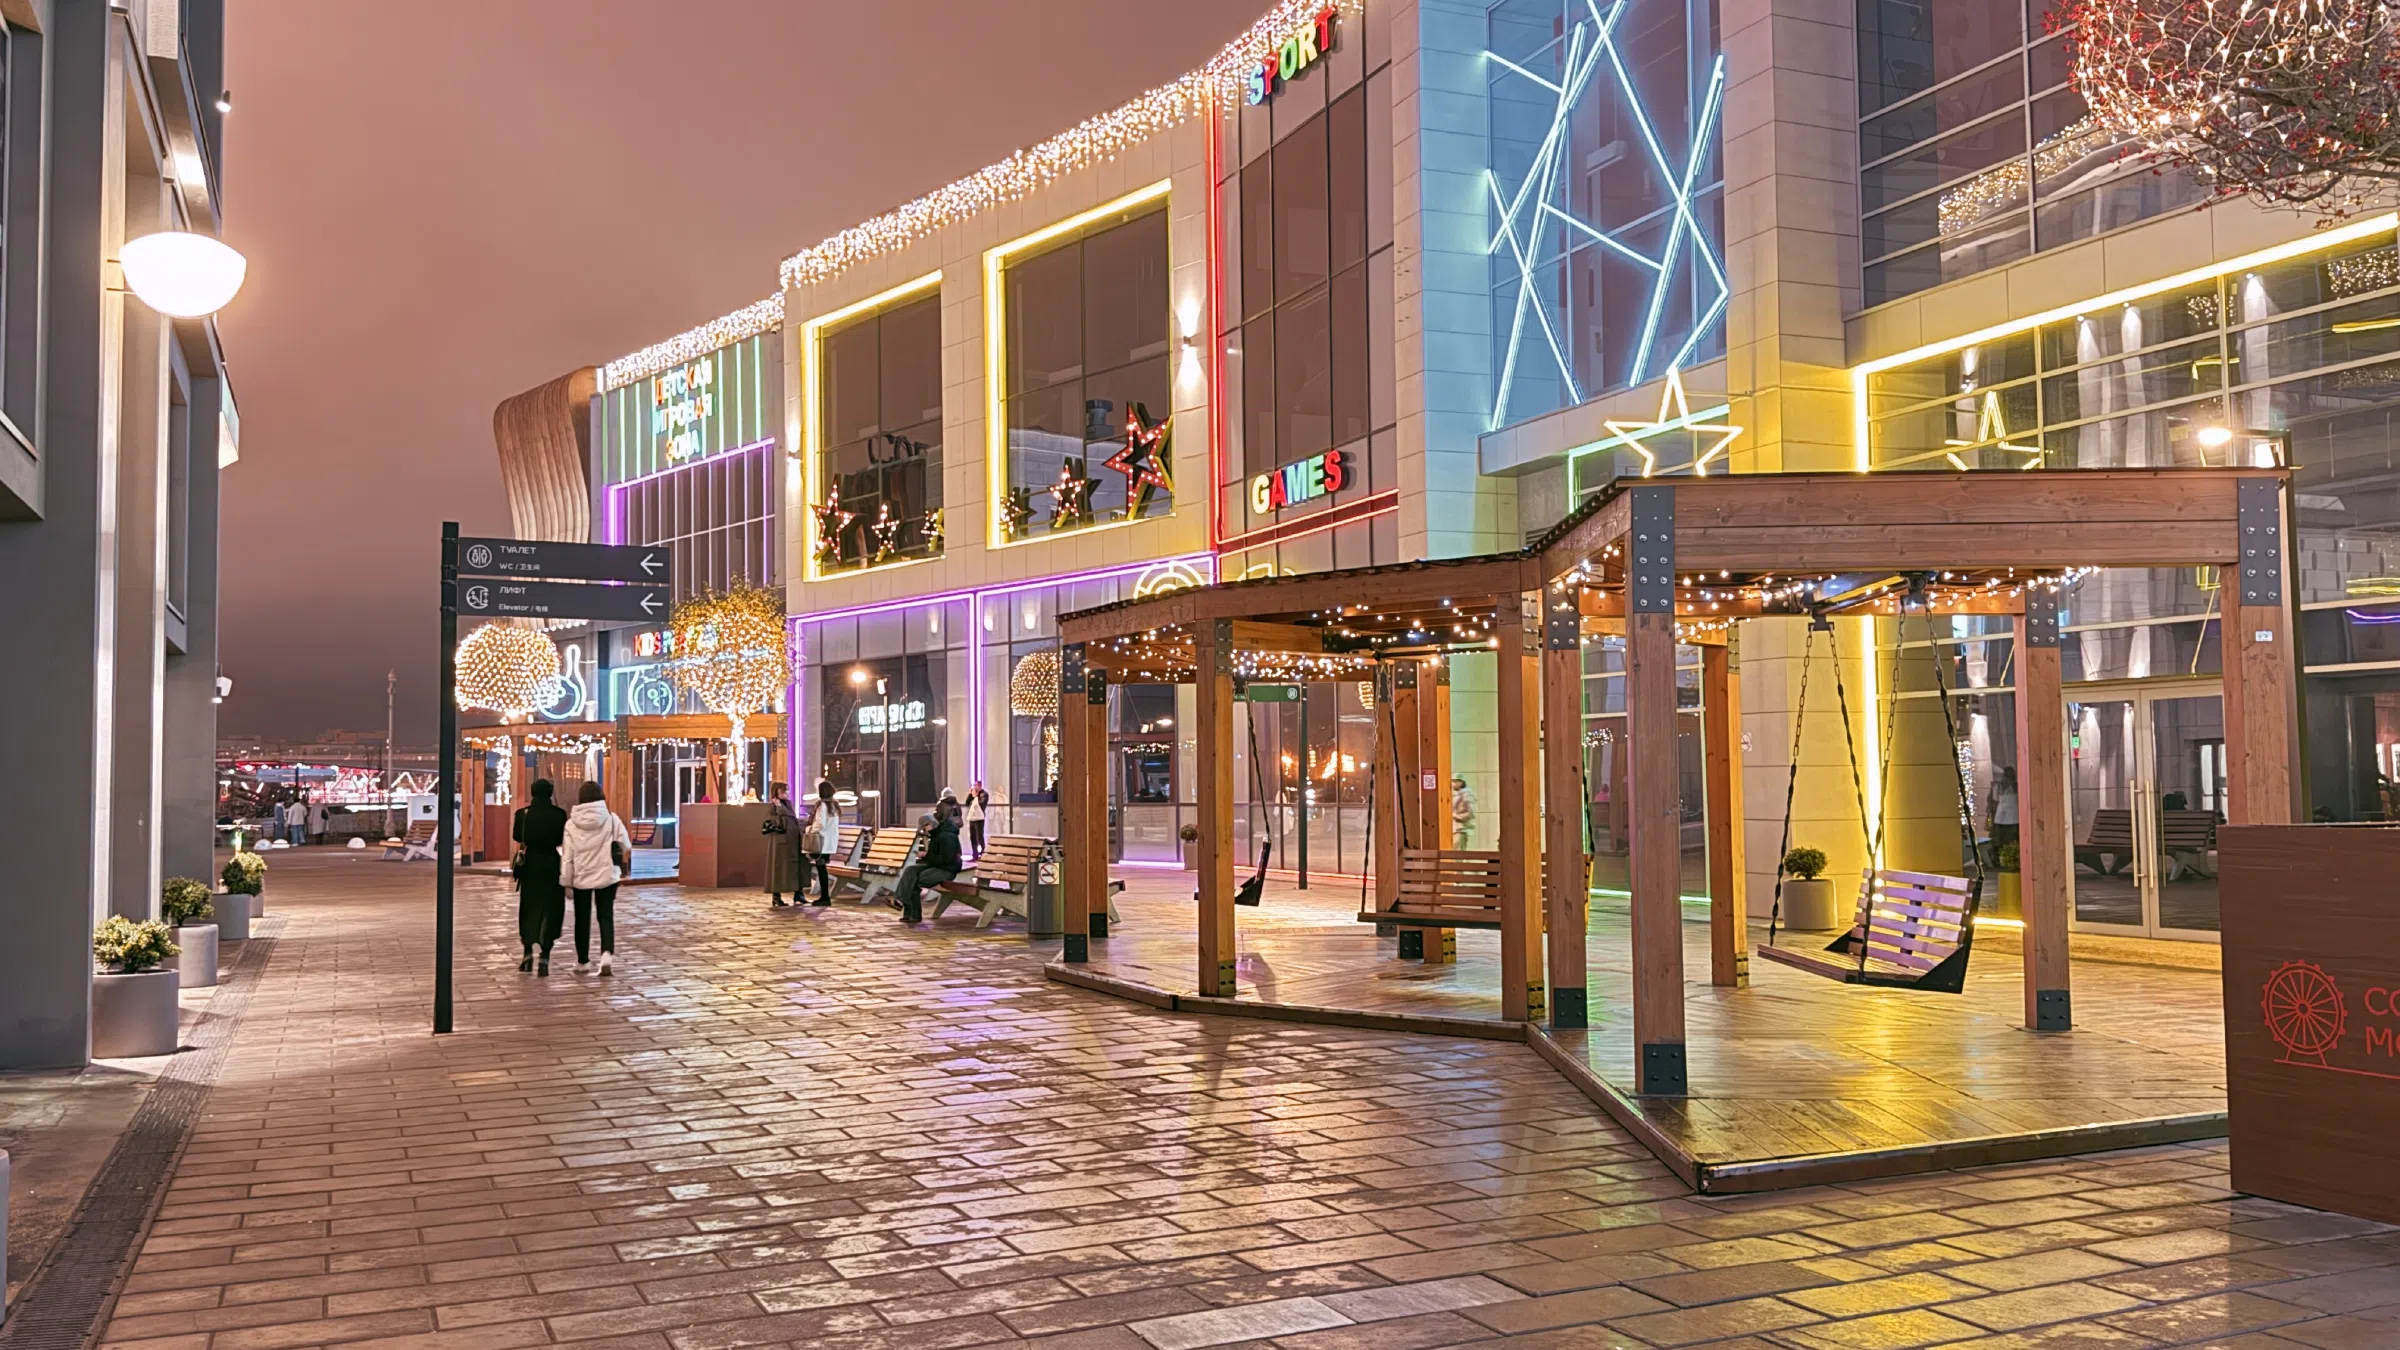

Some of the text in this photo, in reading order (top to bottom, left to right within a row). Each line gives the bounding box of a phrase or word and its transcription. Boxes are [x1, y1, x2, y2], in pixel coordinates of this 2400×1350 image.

[1250, 5, 1337, 106] SPORT
[655, 359, 713, 406] ДЕТСКАЯ
[666, 429, 701, 461] ЗОНА
[1251, 449, 1342, 515] GAMES
[500, 545, 536, 554] ТУАЛЕТ
[499, 586, 526, 594] ЛИФТ
